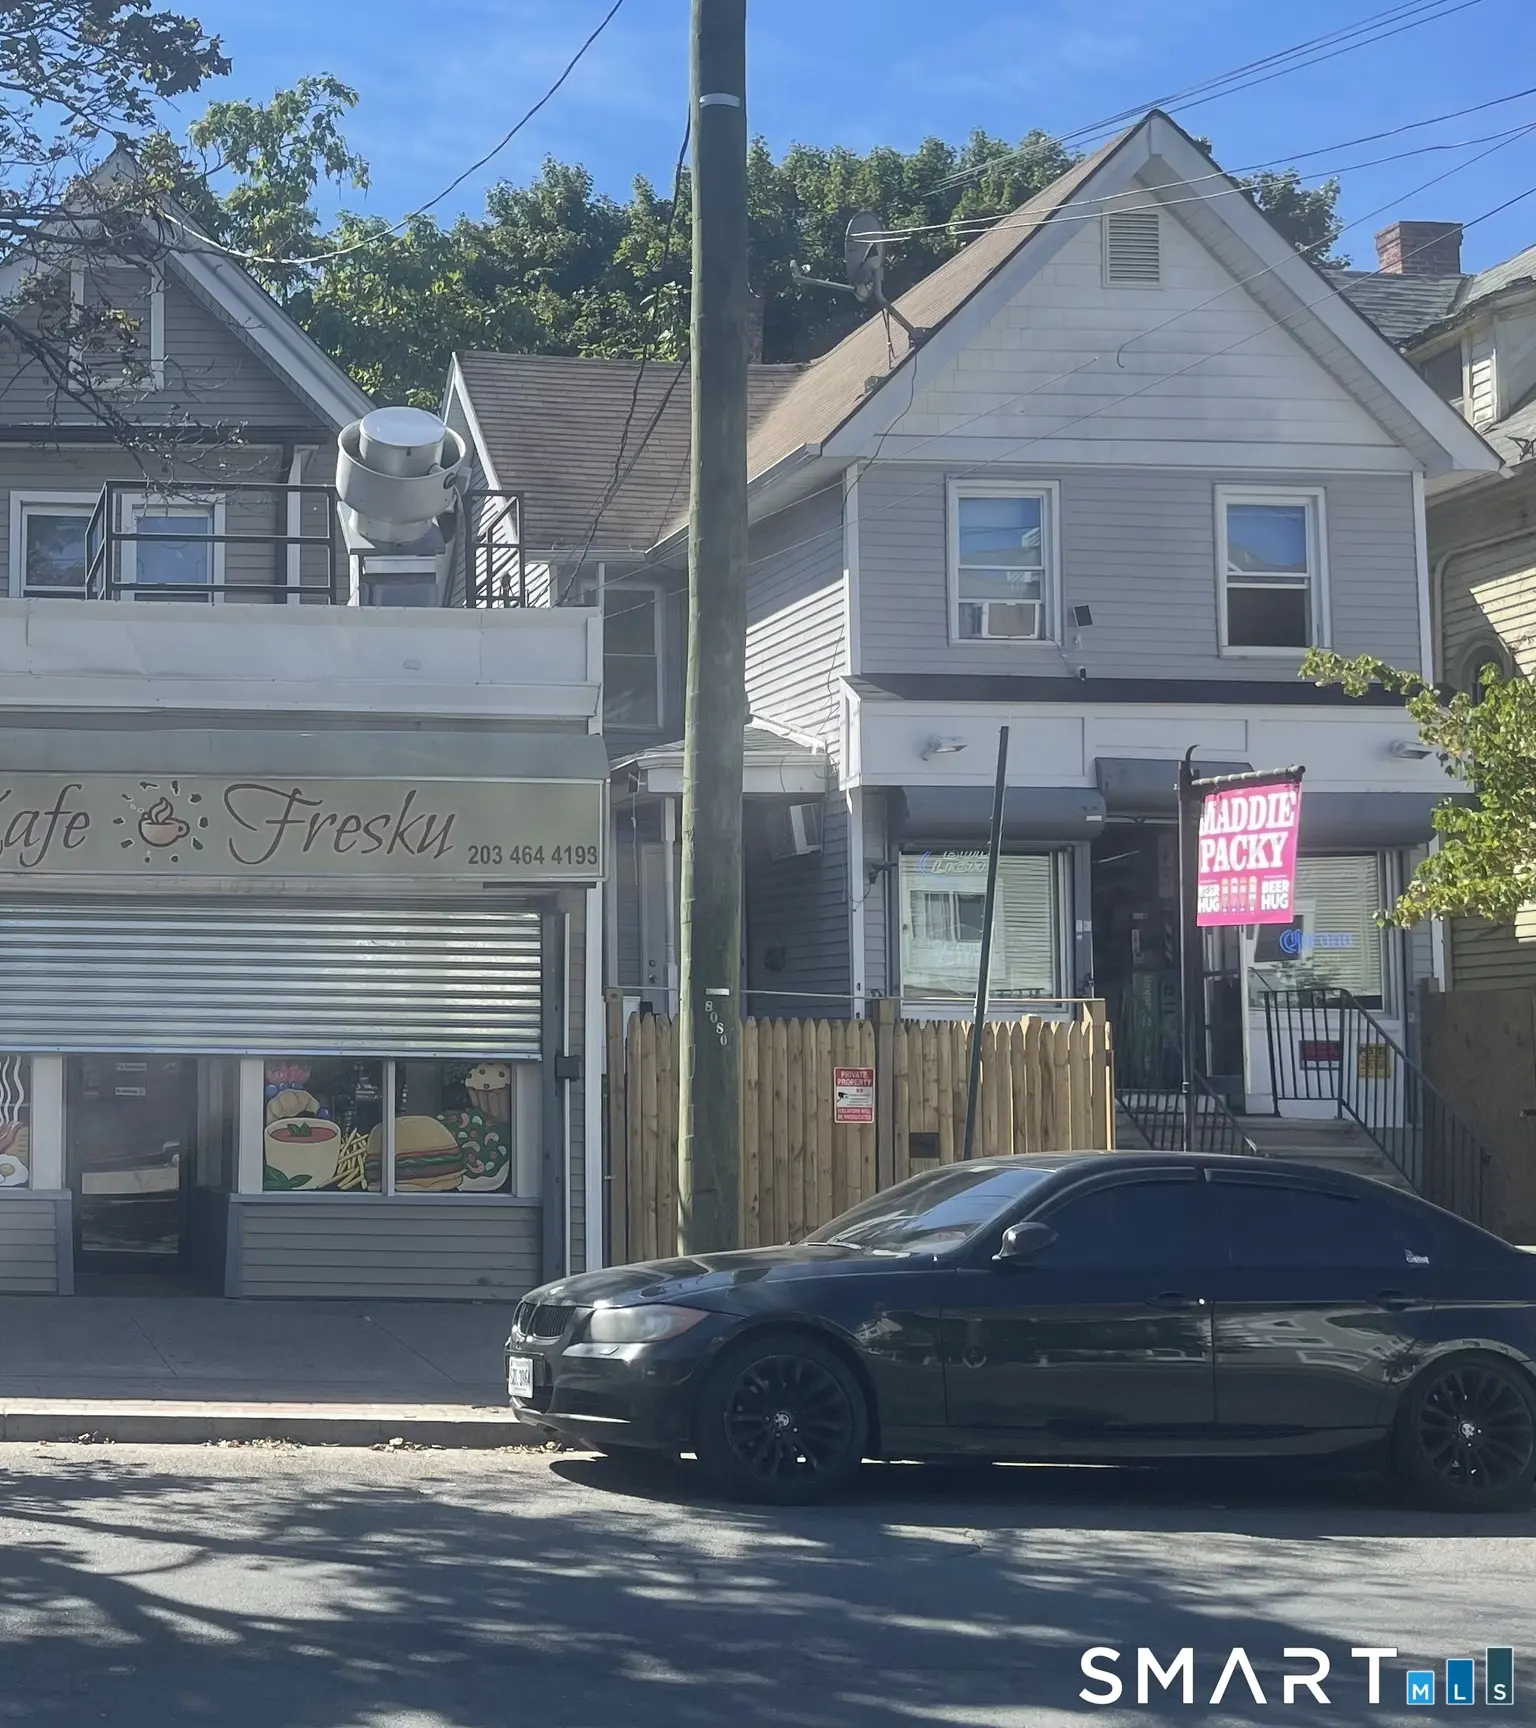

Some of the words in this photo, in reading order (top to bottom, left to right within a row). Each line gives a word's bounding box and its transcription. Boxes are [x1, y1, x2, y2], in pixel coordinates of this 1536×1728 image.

[1199, 791, 1297, 836] MADDIE
[224, 783, 456, 865] Fresku
[468, 845, 503, 865] 203
[509, 845, 545, 865] 464
[1200, 832, 1289, 874] PACKY
[1198, 884, 1220, 898] BEER
[1261, 880, 1290, 894] BEER
[1198, 897, 1220, 914] HUG
[1261, 893, 1289, 910] HUG
[705, 1001, 727, 1046] 8080
